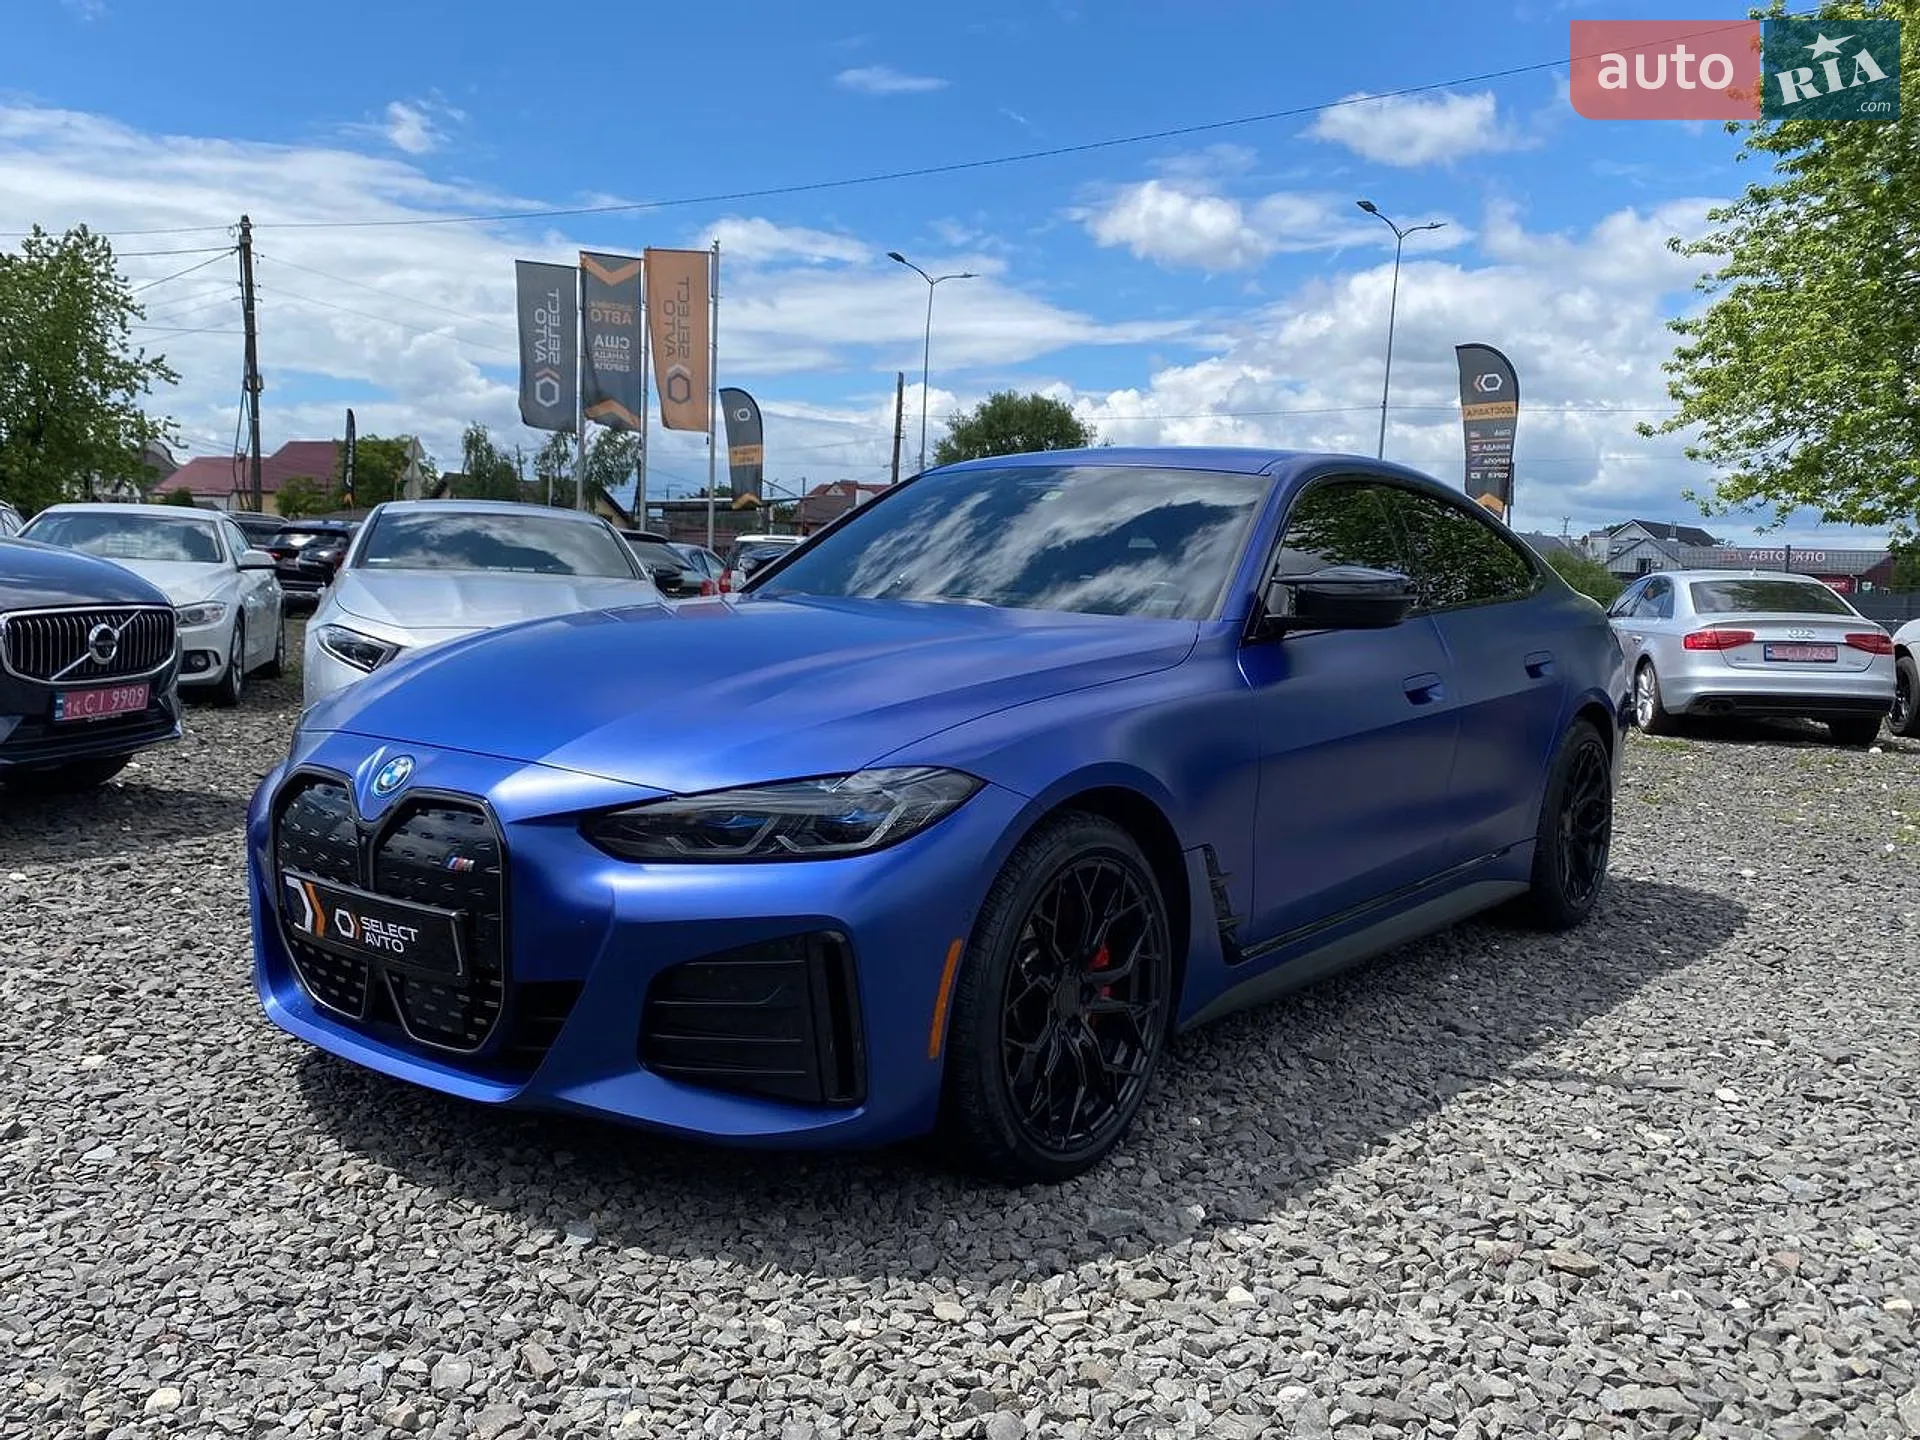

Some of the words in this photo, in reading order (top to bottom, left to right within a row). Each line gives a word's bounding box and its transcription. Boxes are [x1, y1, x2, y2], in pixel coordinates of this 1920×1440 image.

[111, 687, 145, 710] 9909
[360, 916, 419, 942] SELECT
[364, 932, 405, 953] AVTO
